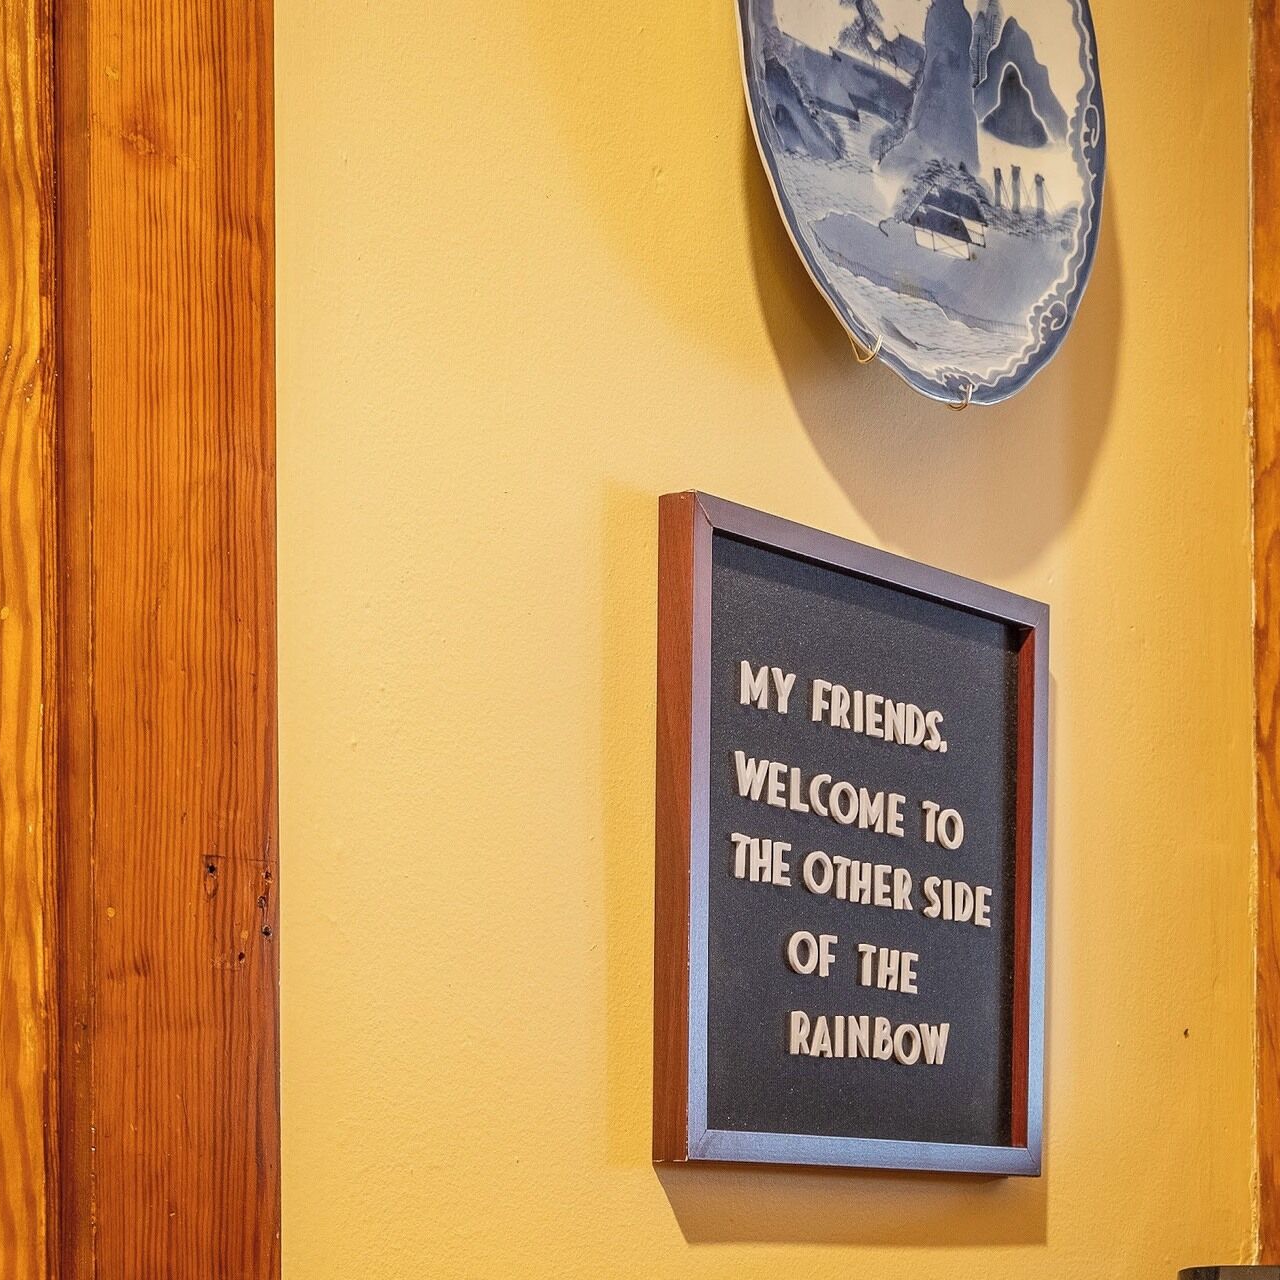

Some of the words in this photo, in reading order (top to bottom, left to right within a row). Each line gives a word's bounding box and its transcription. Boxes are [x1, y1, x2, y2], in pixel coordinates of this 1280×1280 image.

[739, 659, 797, 714] MY
[734, 750, 906, 838] WELCOME
[922, 799, 964, 850] TO
[730, 832, 792, 887] THE
[803, 850, 914, 911] OTHER
[922, 876, 992, 928] SIDE
[787, 930, 838, 977] OF
[858, 943, 919, 995] THE
[789, 1010, 950, 1066] RAINBOW
